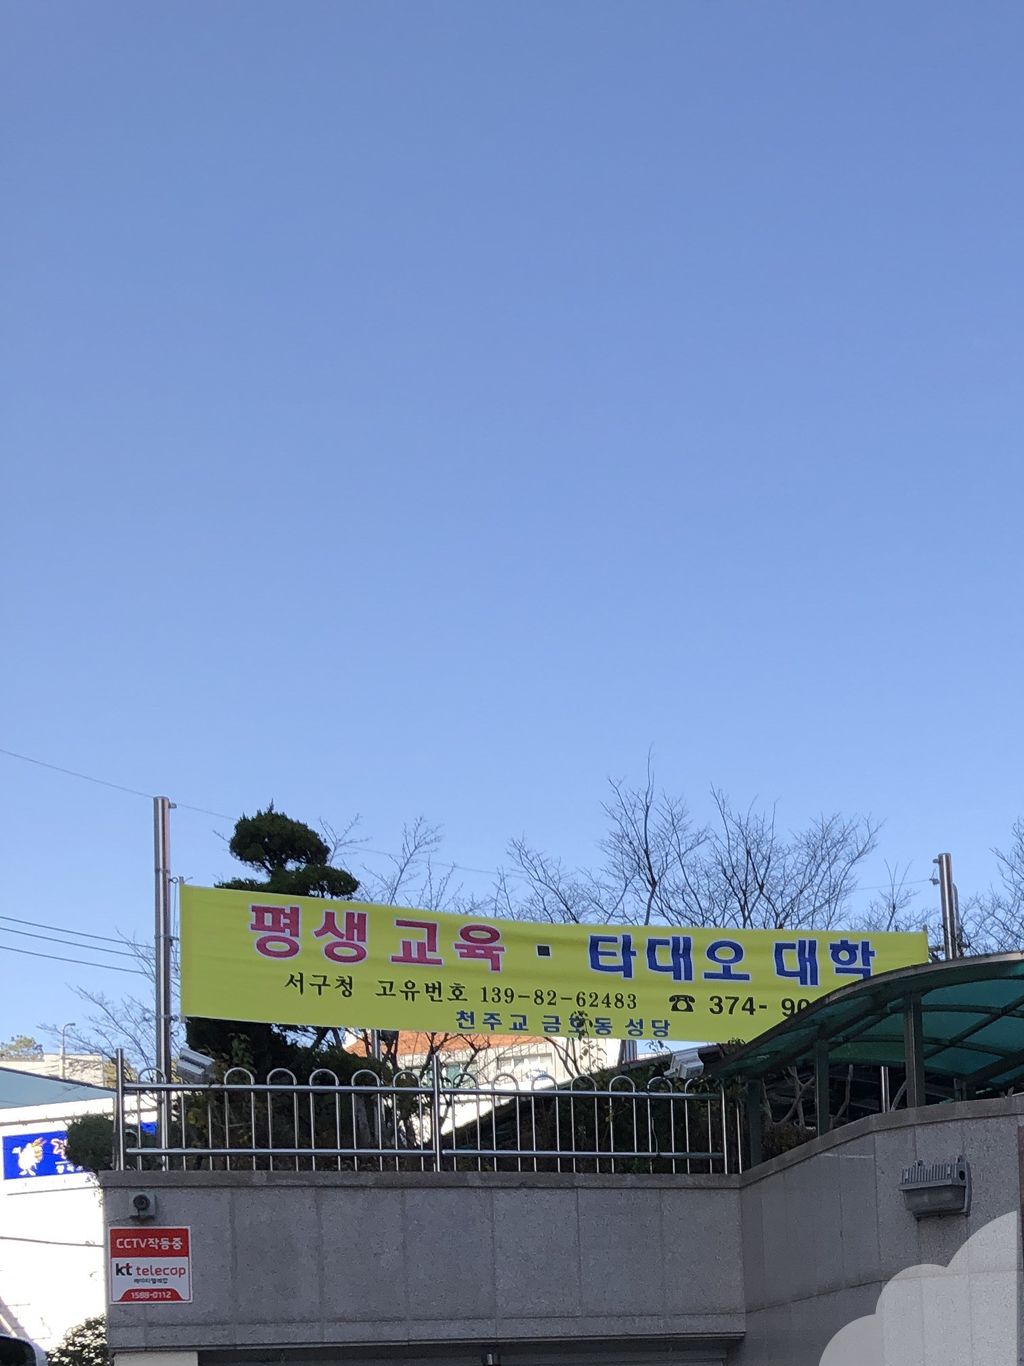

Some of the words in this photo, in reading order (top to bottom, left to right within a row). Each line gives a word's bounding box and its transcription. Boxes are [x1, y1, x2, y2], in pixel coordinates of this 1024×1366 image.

[589, 934, 750, 982] 타대오
[774, 939, 876, 986] 대학
[284, 972, 354, 998] 서구청
[375, 980, 468, 1002] 고유번호
[480, 986, 637, 1010] 139-82-62483
[455, 1010, 529, 1032] 천주교
[624, 1018, 671, 1038] 성당
[115, 1263, 133, 1276] kt
[136, 1265, 187, 1278] telecop
